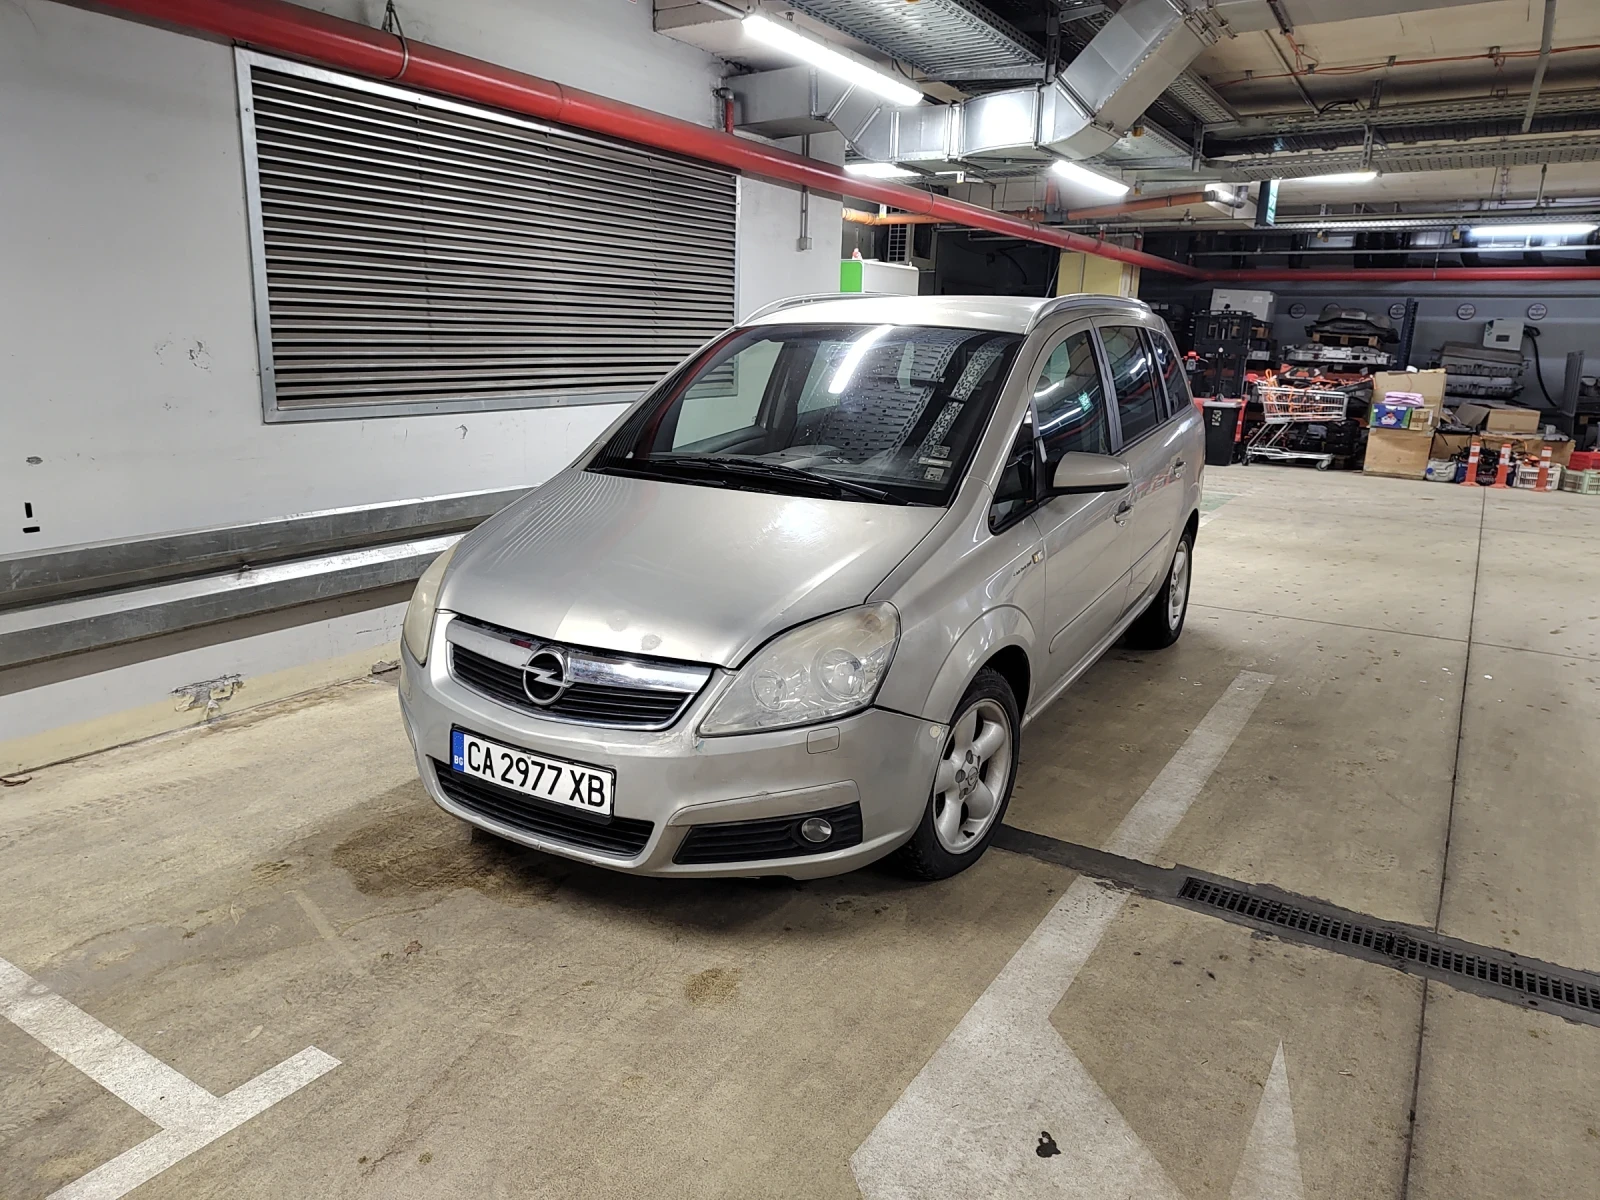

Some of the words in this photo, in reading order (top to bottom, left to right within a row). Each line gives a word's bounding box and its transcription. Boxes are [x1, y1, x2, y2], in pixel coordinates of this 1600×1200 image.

[454, 755, 464, 766] BG
[467, 741, 495, 778] CA
[500, 752, 562, 795] 2977
[568, 769, 606, 808] XB
